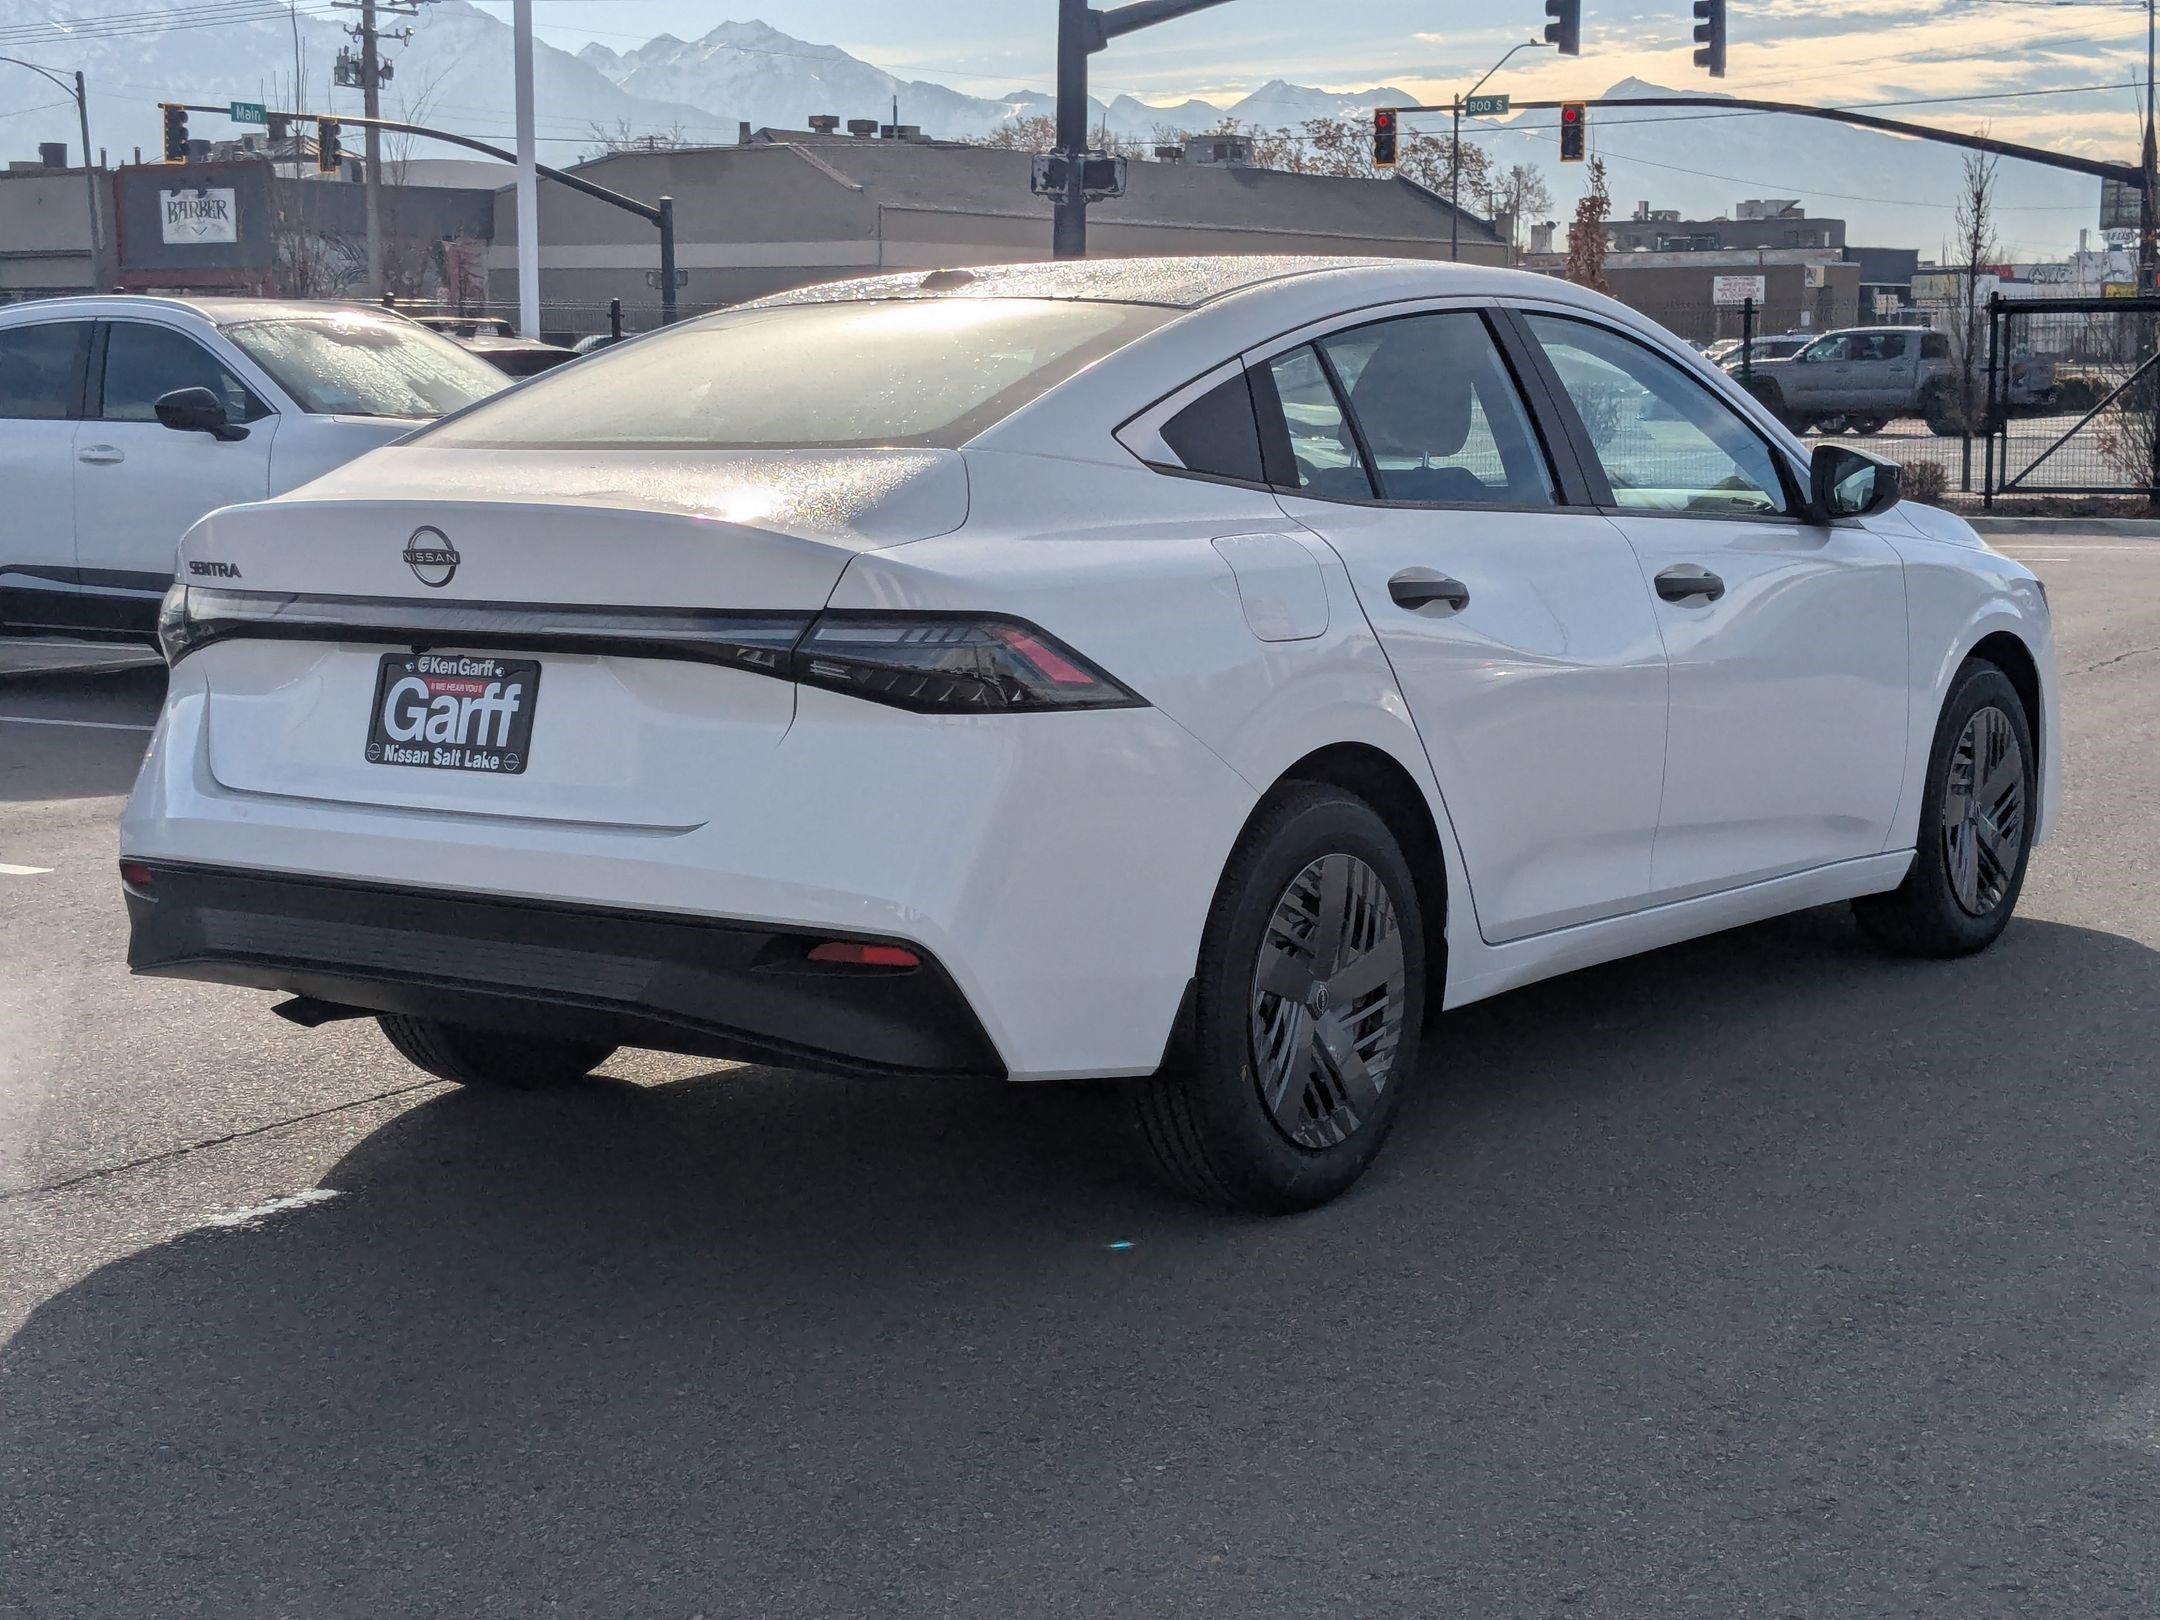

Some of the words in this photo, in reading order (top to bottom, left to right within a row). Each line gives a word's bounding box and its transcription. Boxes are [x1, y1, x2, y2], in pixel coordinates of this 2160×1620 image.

[236, 104, 261, 122] Main
[1495, 99, 1503, 111] S
[167, 199, 229, 225] BARBER
[403, 552, 457, 563] NISSAN
[189, 560, 243, 578] SENTRA
[430, 657, 458, 675] Ken
[458, 658, 496, 677] Garff
[384, 676, 522, 748] Garff
[384, 744, 430, 764] Nissan
[433, 747, 461, 767] Salt
[464, 750, 500, 770] Lake
